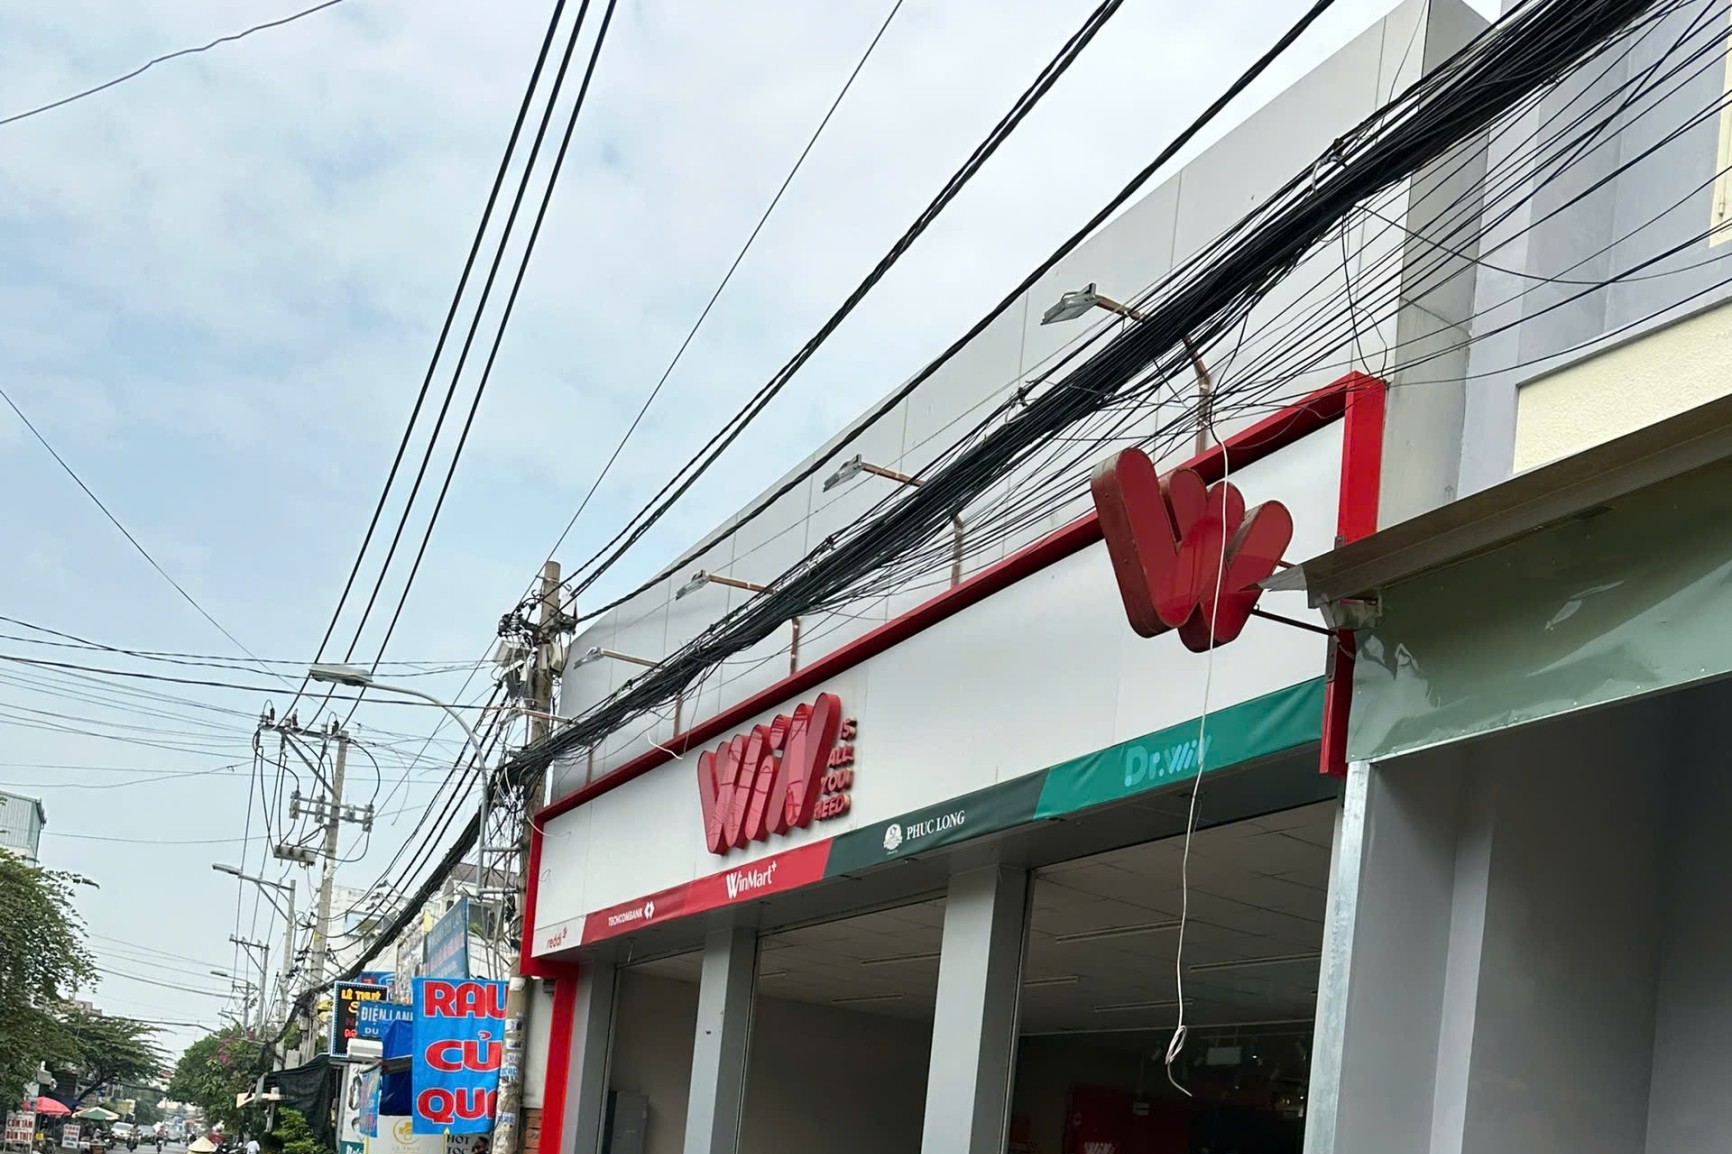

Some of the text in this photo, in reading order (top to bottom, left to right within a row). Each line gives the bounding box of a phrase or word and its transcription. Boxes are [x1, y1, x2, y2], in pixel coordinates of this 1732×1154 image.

[826, 743, 855, 769] ALL
[813, 792, 852, 822] NEED
[935, 809, 966, 832] LONG
[608, 907, 644, 927] TECHCOMBANK
[423, 980, 509, 1020] RAU
[424, 1030, 503, 1072] CỦ
